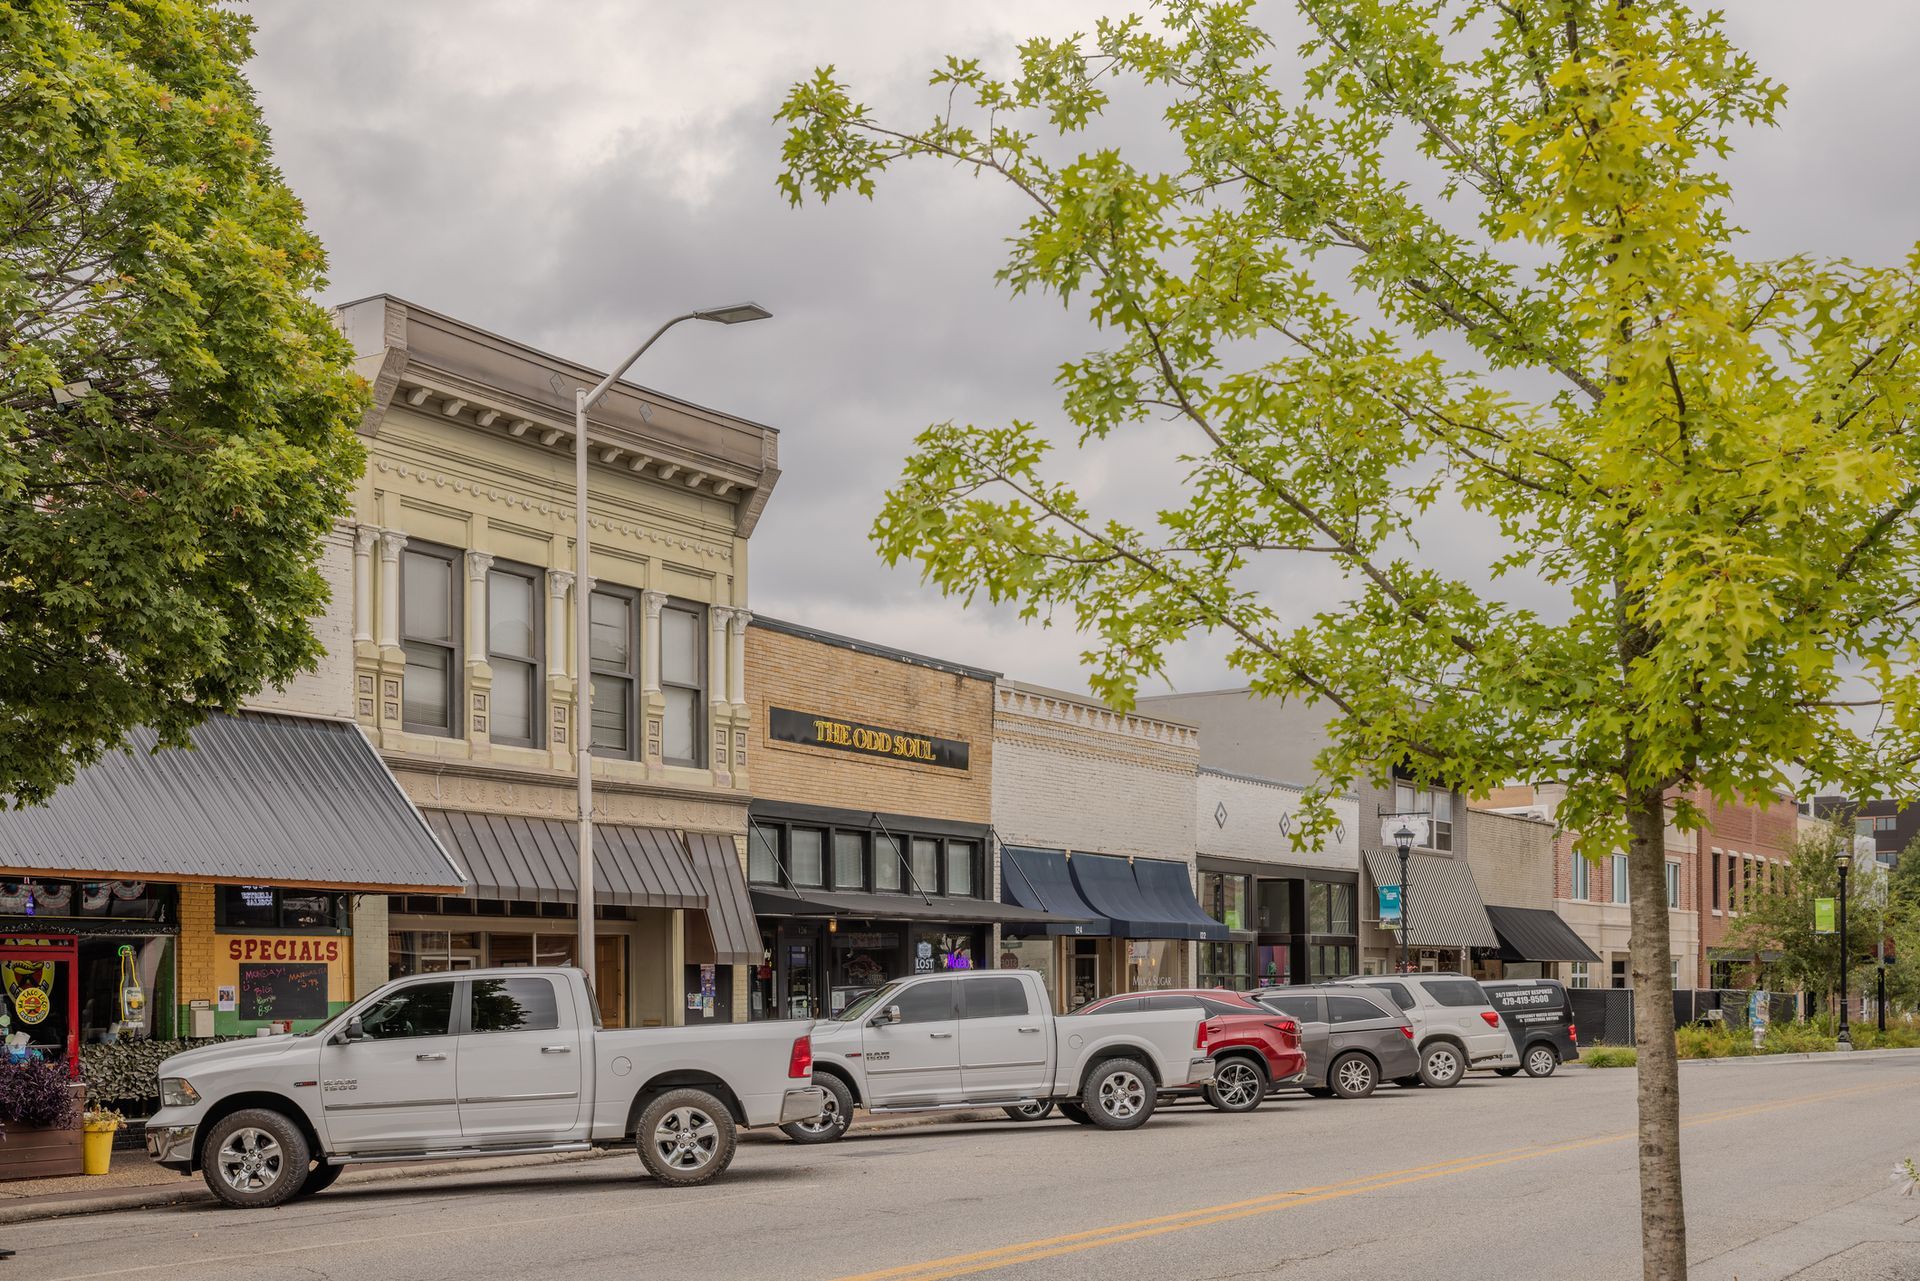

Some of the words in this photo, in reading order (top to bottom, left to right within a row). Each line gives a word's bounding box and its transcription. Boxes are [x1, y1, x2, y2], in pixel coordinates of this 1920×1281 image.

[813, 720, 852, 746] THE
[852, 728, 892, 752] ODD
[892, 735, 936, 760] SOUL
[229, 938, 339, 961] SPECIALS
[916, 958, 934, 969] LOST
[1152, 975, 1173, 986] SUGAR
[22, 989, 38, 999] TACO
[1502, 995, 1549, 1005] 479-419-9500
